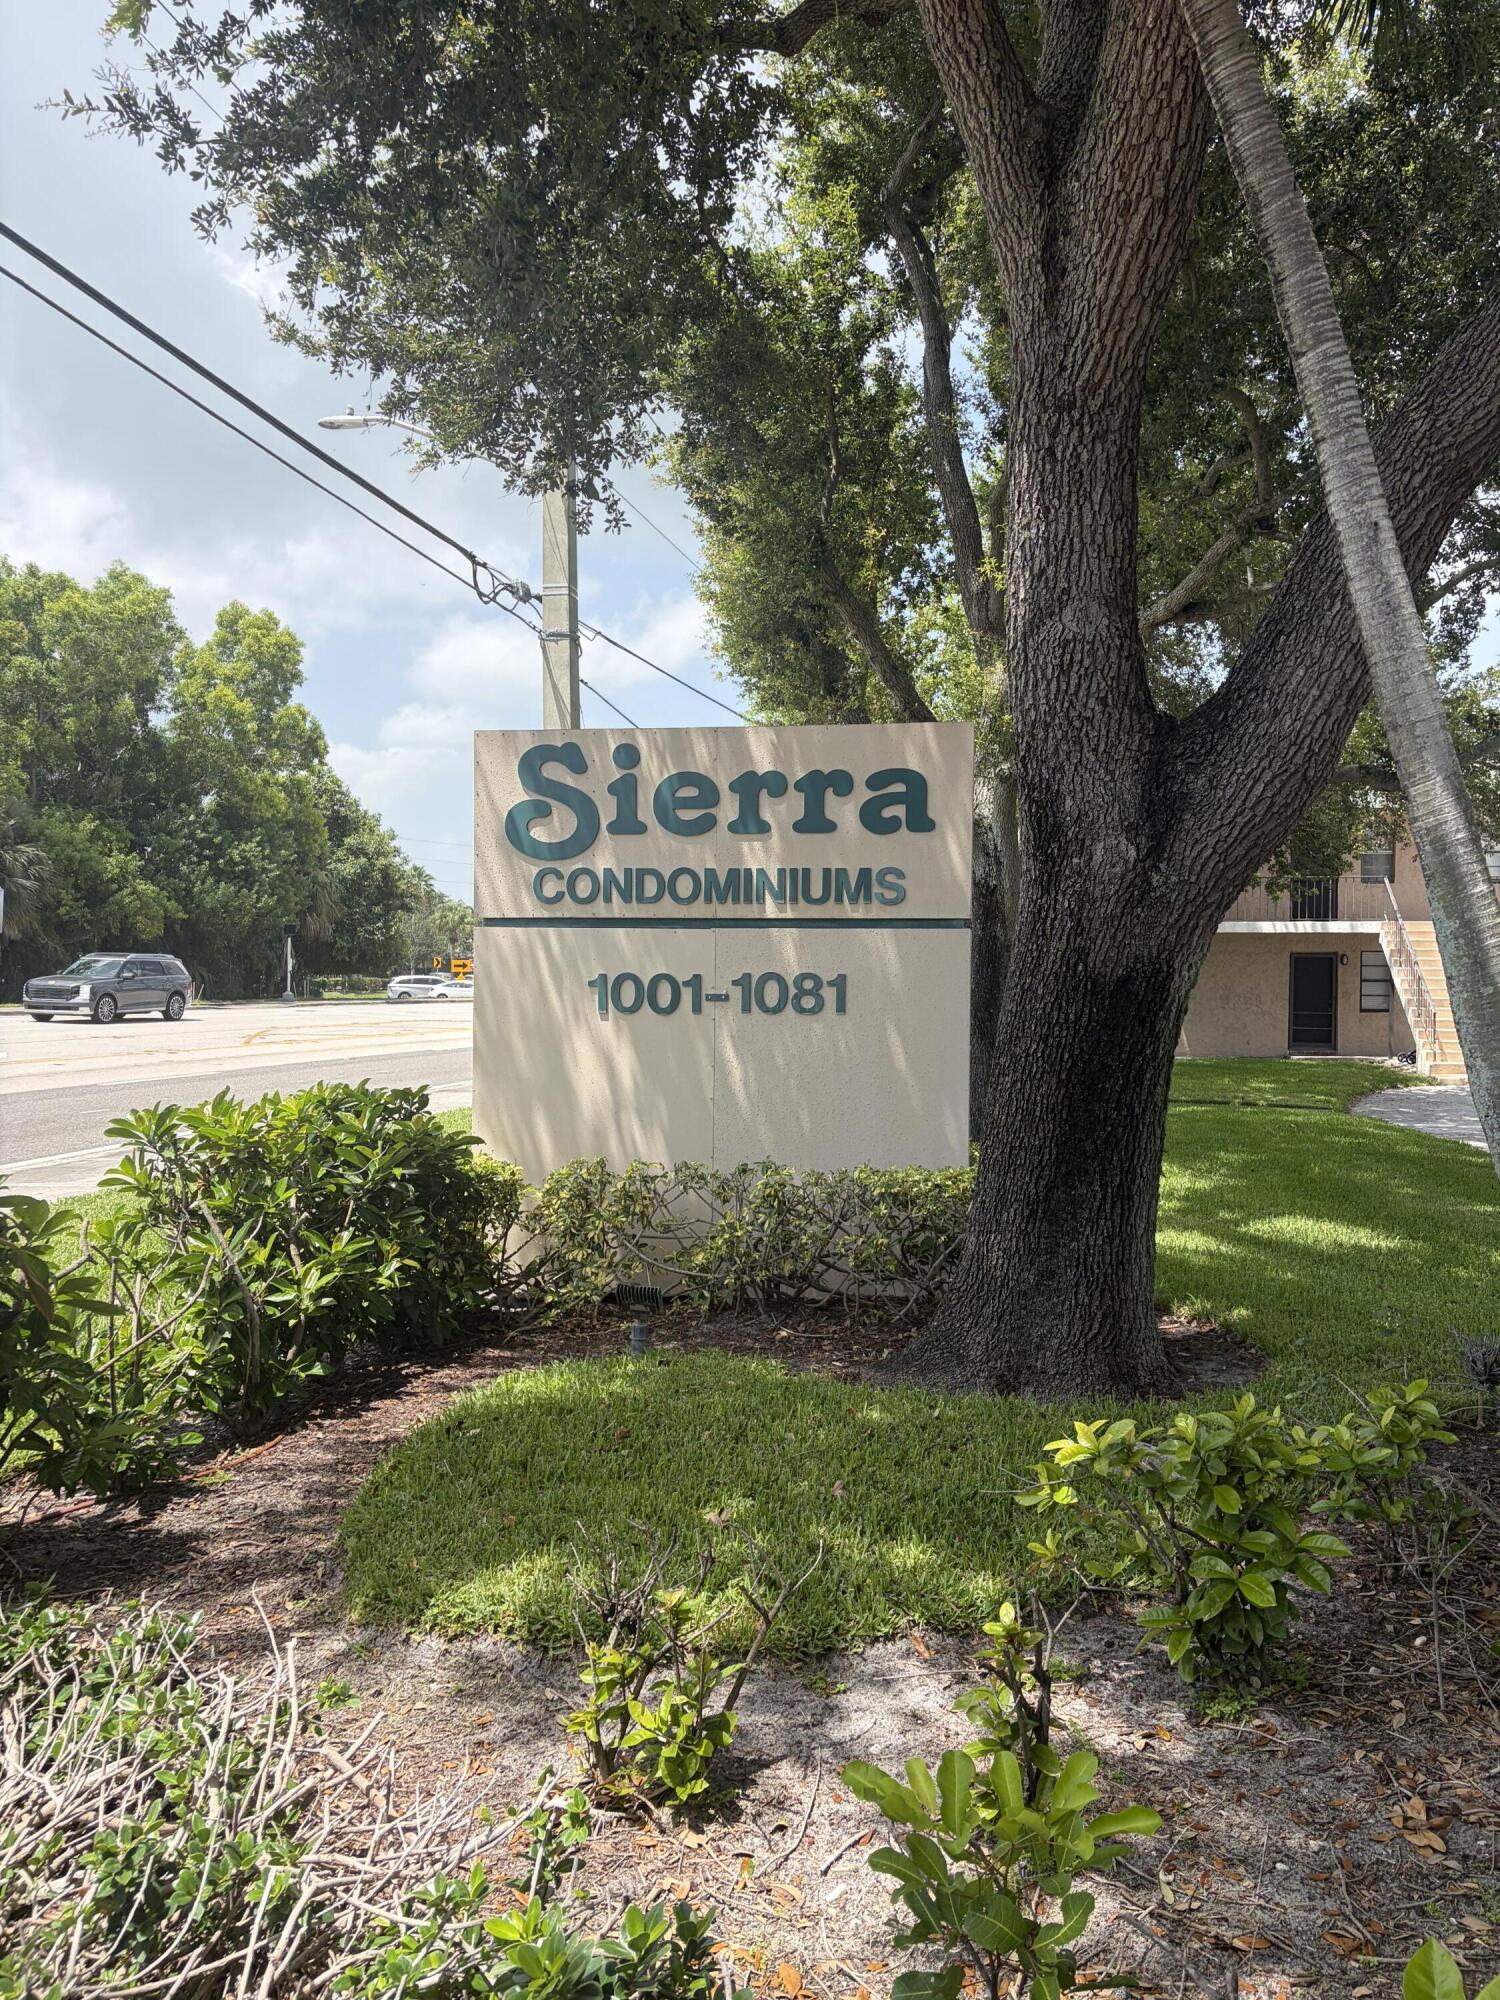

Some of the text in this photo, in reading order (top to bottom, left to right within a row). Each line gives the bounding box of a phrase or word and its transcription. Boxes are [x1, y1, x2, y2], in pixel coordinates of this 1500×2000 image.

[505, 742, 936, 861] Sierra
[533, 866, 906, 905] CONDOMINIUMS
[588, 972, 847, 1016] 1001-1081
